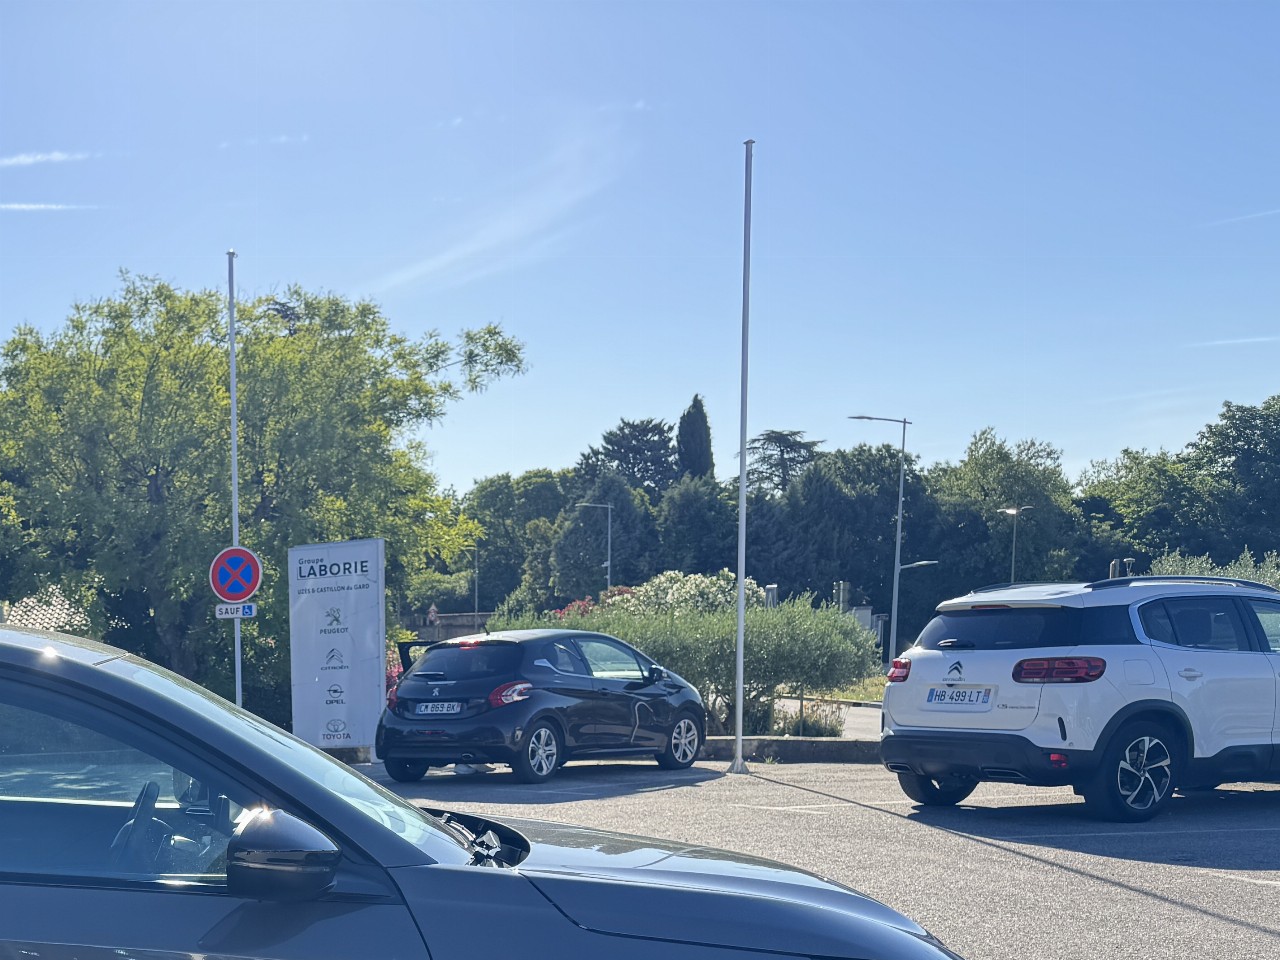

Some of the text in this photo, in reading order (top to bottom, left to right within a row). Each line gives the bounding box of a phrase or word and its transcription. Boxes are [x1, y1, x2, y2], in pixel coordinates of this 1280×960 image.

[298, 558, 324, 566] Groupe
[299, 560, 368, 578] LABORIE
[218, 607, 240, 615] SAUF
